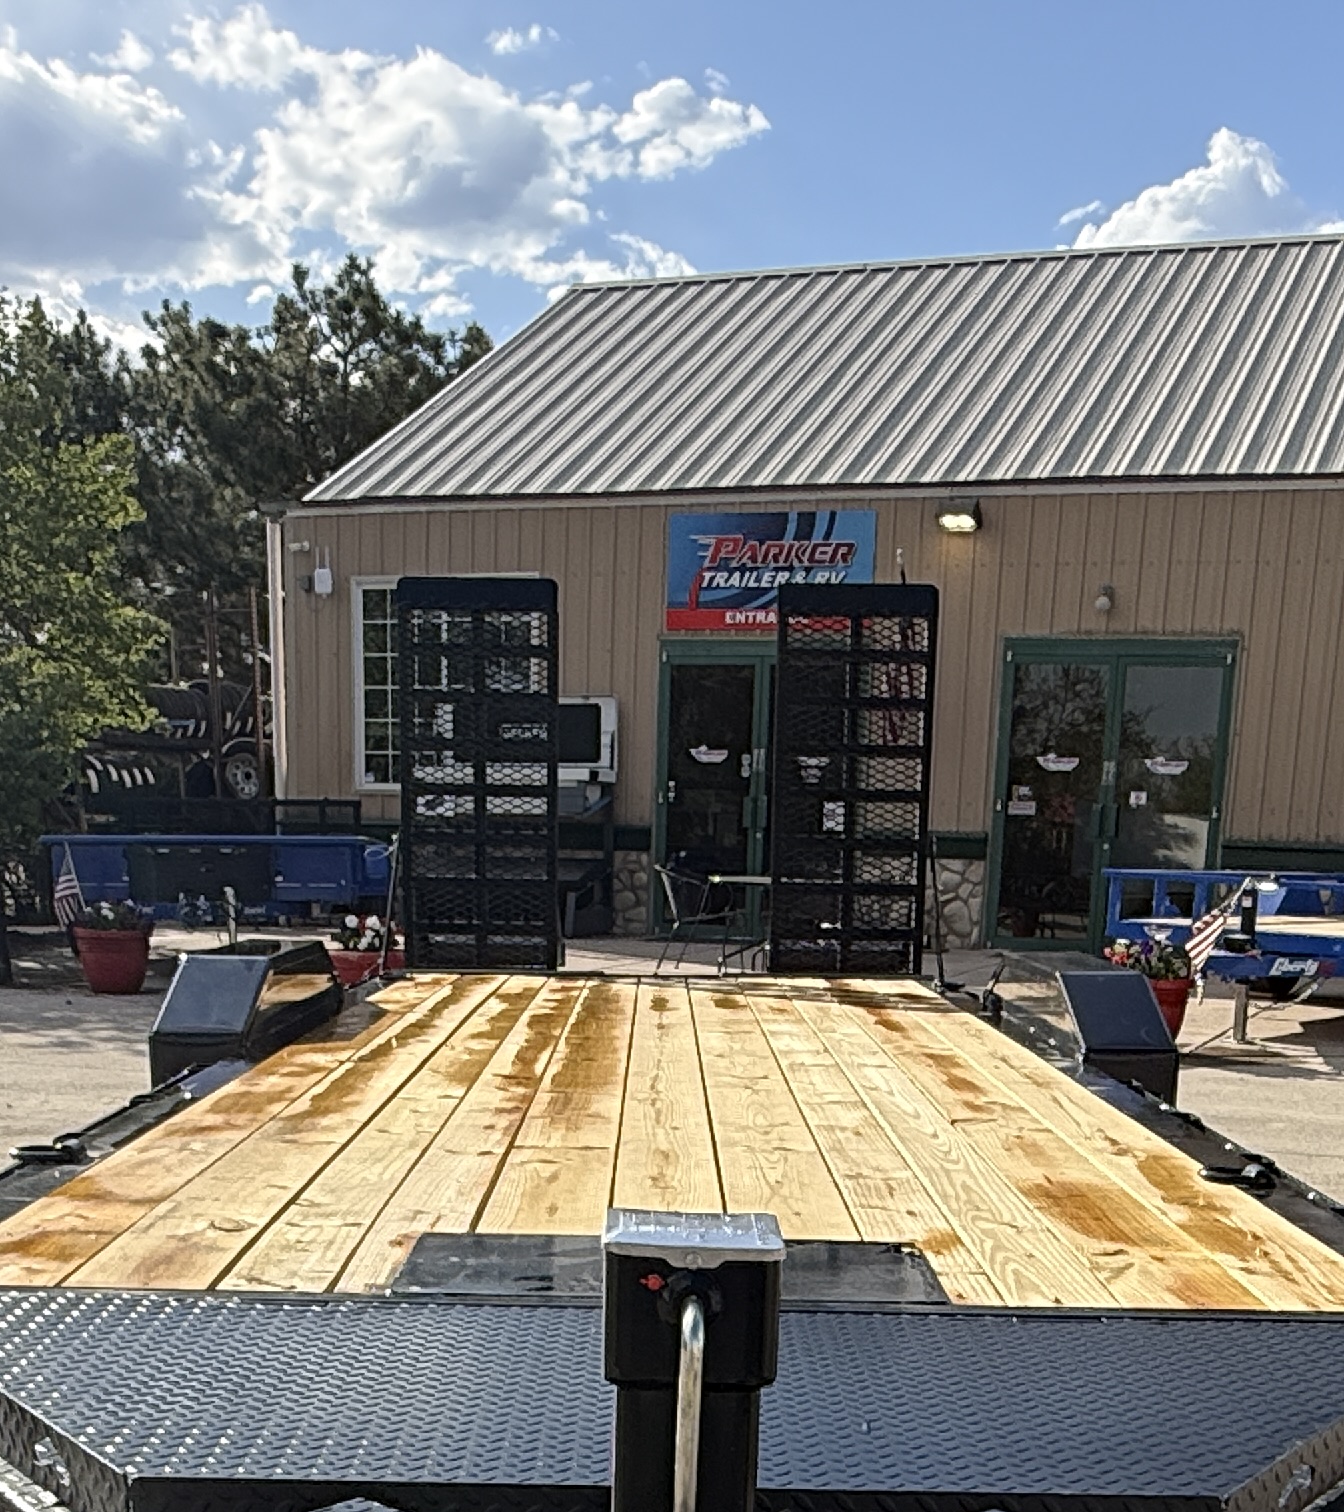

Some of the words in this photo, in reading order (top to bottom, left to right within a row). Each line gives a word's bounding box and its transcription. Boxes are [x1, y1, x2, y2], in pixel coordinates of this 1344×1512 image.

[705, 534, 857, 568] PARKER
[700, 571, 792, 588] TRAILER
[814, 570, 848, 585] RV
